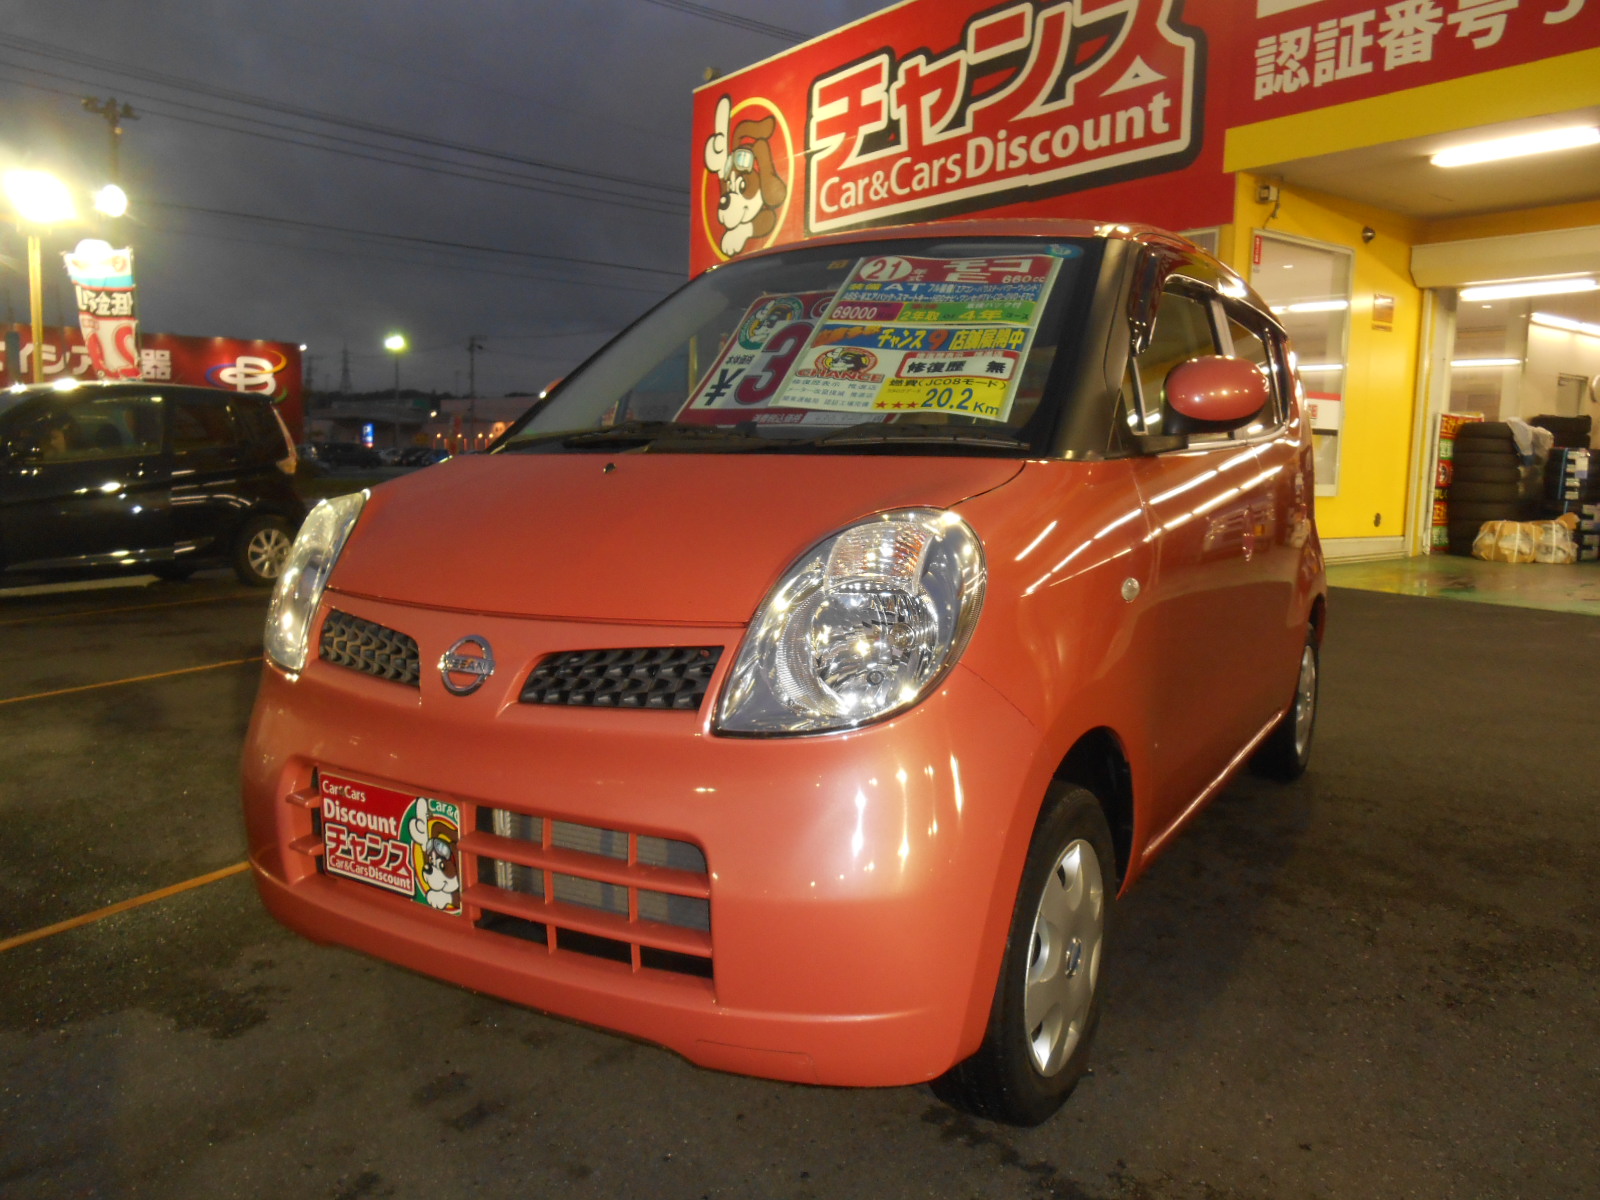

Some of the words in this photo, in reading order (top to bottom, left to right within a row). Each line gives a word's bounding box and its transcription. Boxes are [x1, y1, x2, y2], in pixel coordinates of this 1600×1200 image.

[811, 0, 1192, 171] チャンス
[866, 259, 902, 279] 21
[884, 283, 927, 291] AT
[877, 328, 928, 349] チャンス
[928, 329, 949, 350] 9
[795, 367, 885, 384] CHANCE
[906, 361, 967, 374] 修復歴
[921, 387, 974, 411] 20.2
[323, 797, 397, 836] Discount
[325, 822, 412, 877] チャンス
